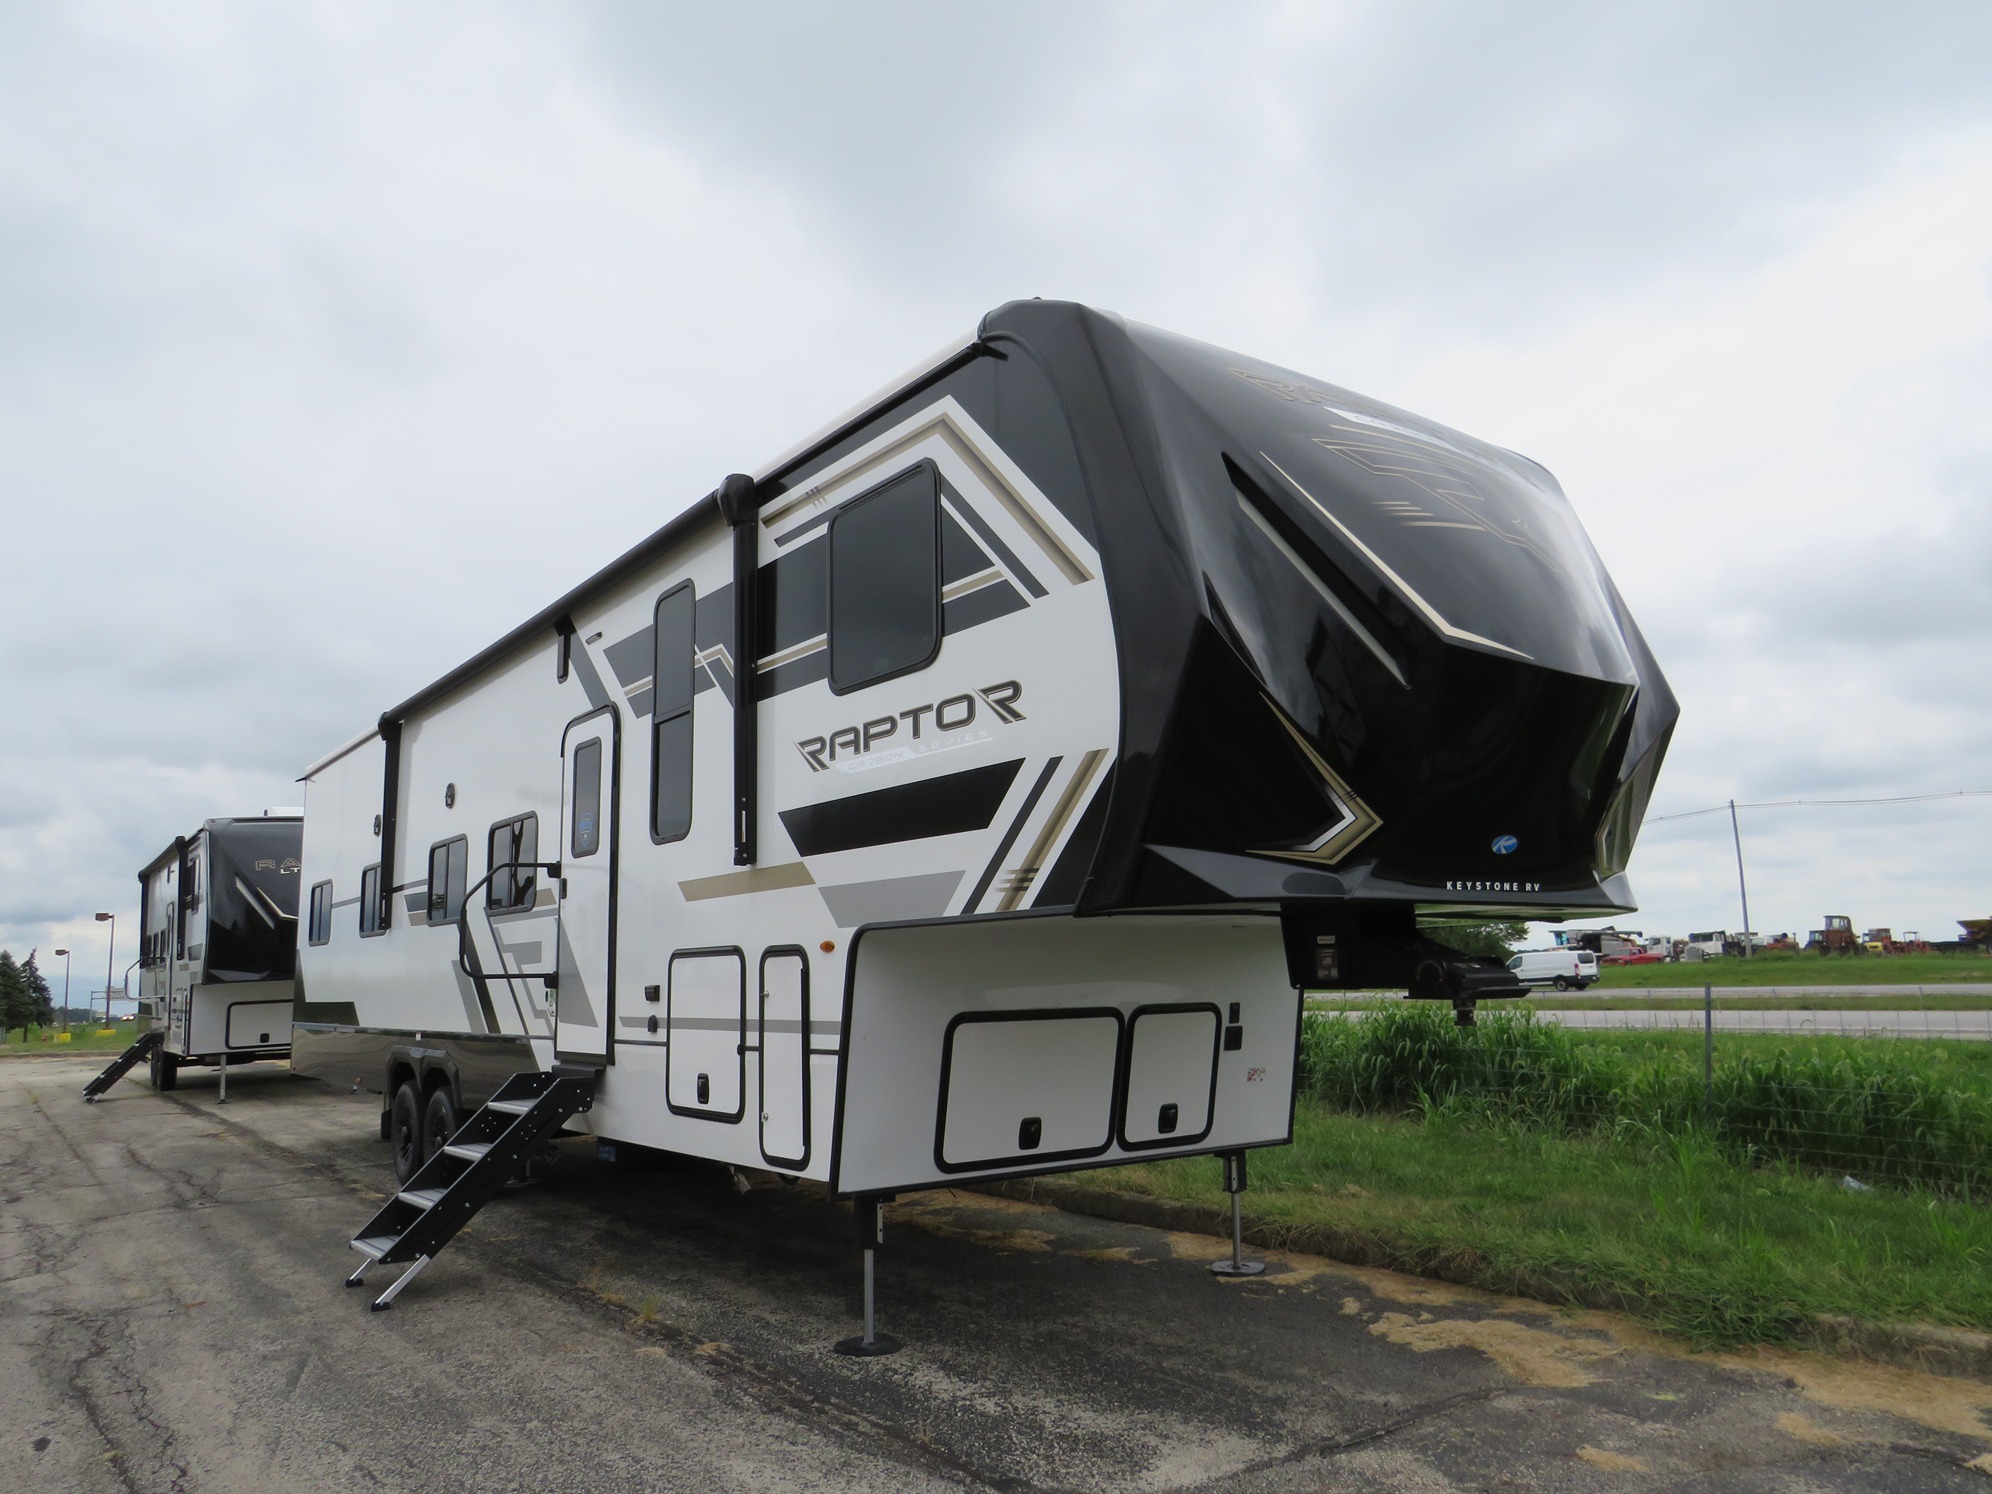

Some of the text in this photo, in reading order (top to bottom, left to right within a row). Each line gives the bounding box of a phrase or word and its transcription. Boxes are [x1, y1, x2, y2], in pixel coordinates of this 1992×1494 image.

[793, 679, 1028, 773] RAPTOR
[847, 729, 990, 771] CARBON SERIES
[1446, 881, 1540, 892] KEYSTONE RV
